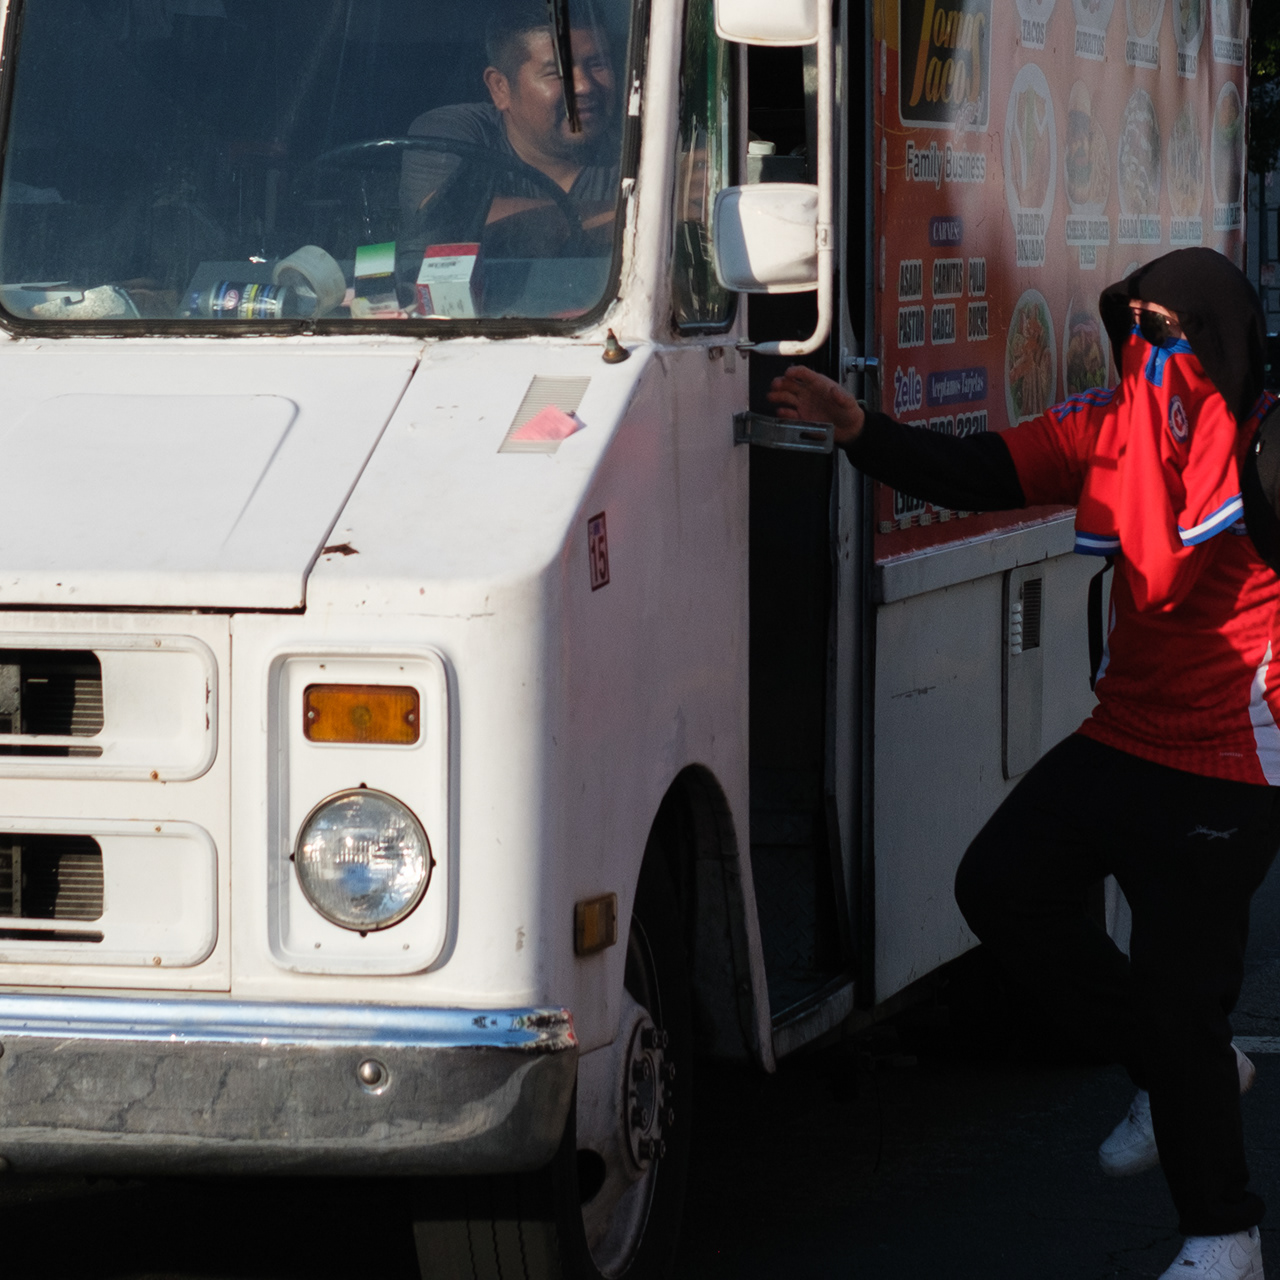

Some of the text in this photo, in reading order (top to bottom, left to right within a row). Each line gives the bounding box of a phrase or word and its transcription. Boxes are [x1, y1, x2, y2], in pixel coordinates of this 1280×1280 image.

[1022, 19, 1045, 45] TACOS
[1075, 30, 1105, 57] BURRITOS
[907, 144, 985, 186] Family Business
[1017, 213, 1044, 235] BURRITO
[900, 263, 922, 297] ASADA
[934, 262, 963, 295] CARNITAS
[969, 261, 985, 293] POLLO
[899, 309, 924, 344] PASTOR
[932, 307, 955, 340] CABEZA
